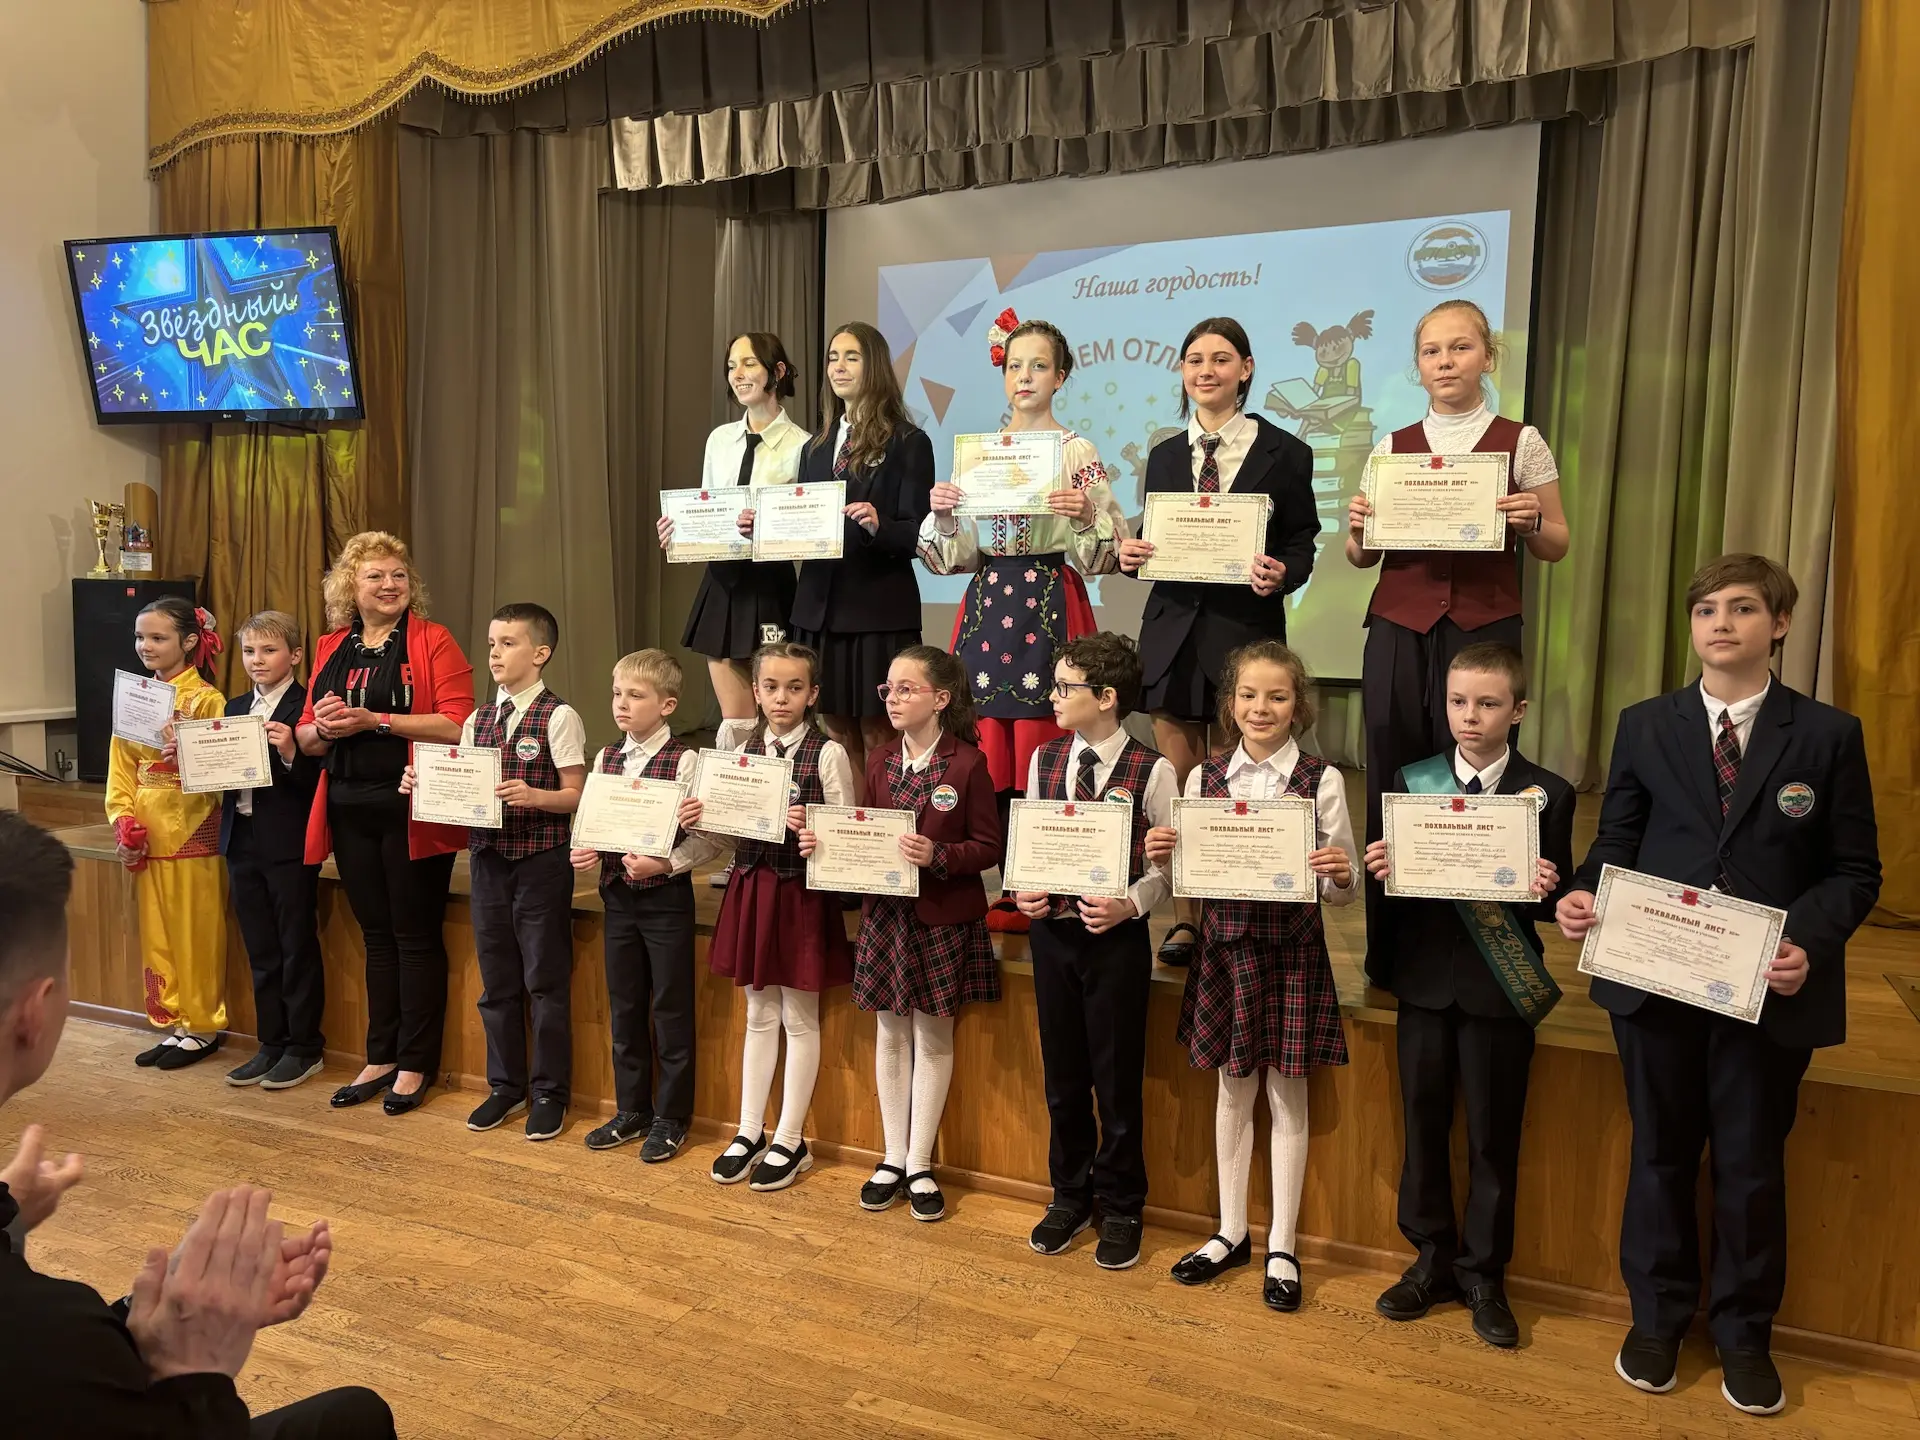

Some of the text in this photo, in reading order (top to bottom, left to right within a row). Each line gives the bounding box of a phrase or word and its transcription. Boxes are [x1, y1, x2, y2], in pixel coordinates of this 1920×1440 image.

[1072, 263, 1262, 300] Наша гордость!
[140, 279, 298, 345] Звёздный
[177, 322, 271, 367] ЧАС
[1644, 906, 1701, 928] ПОХВАЛЬНЫЙ
[1704, 923, 1726, 934] ЛИСТ
